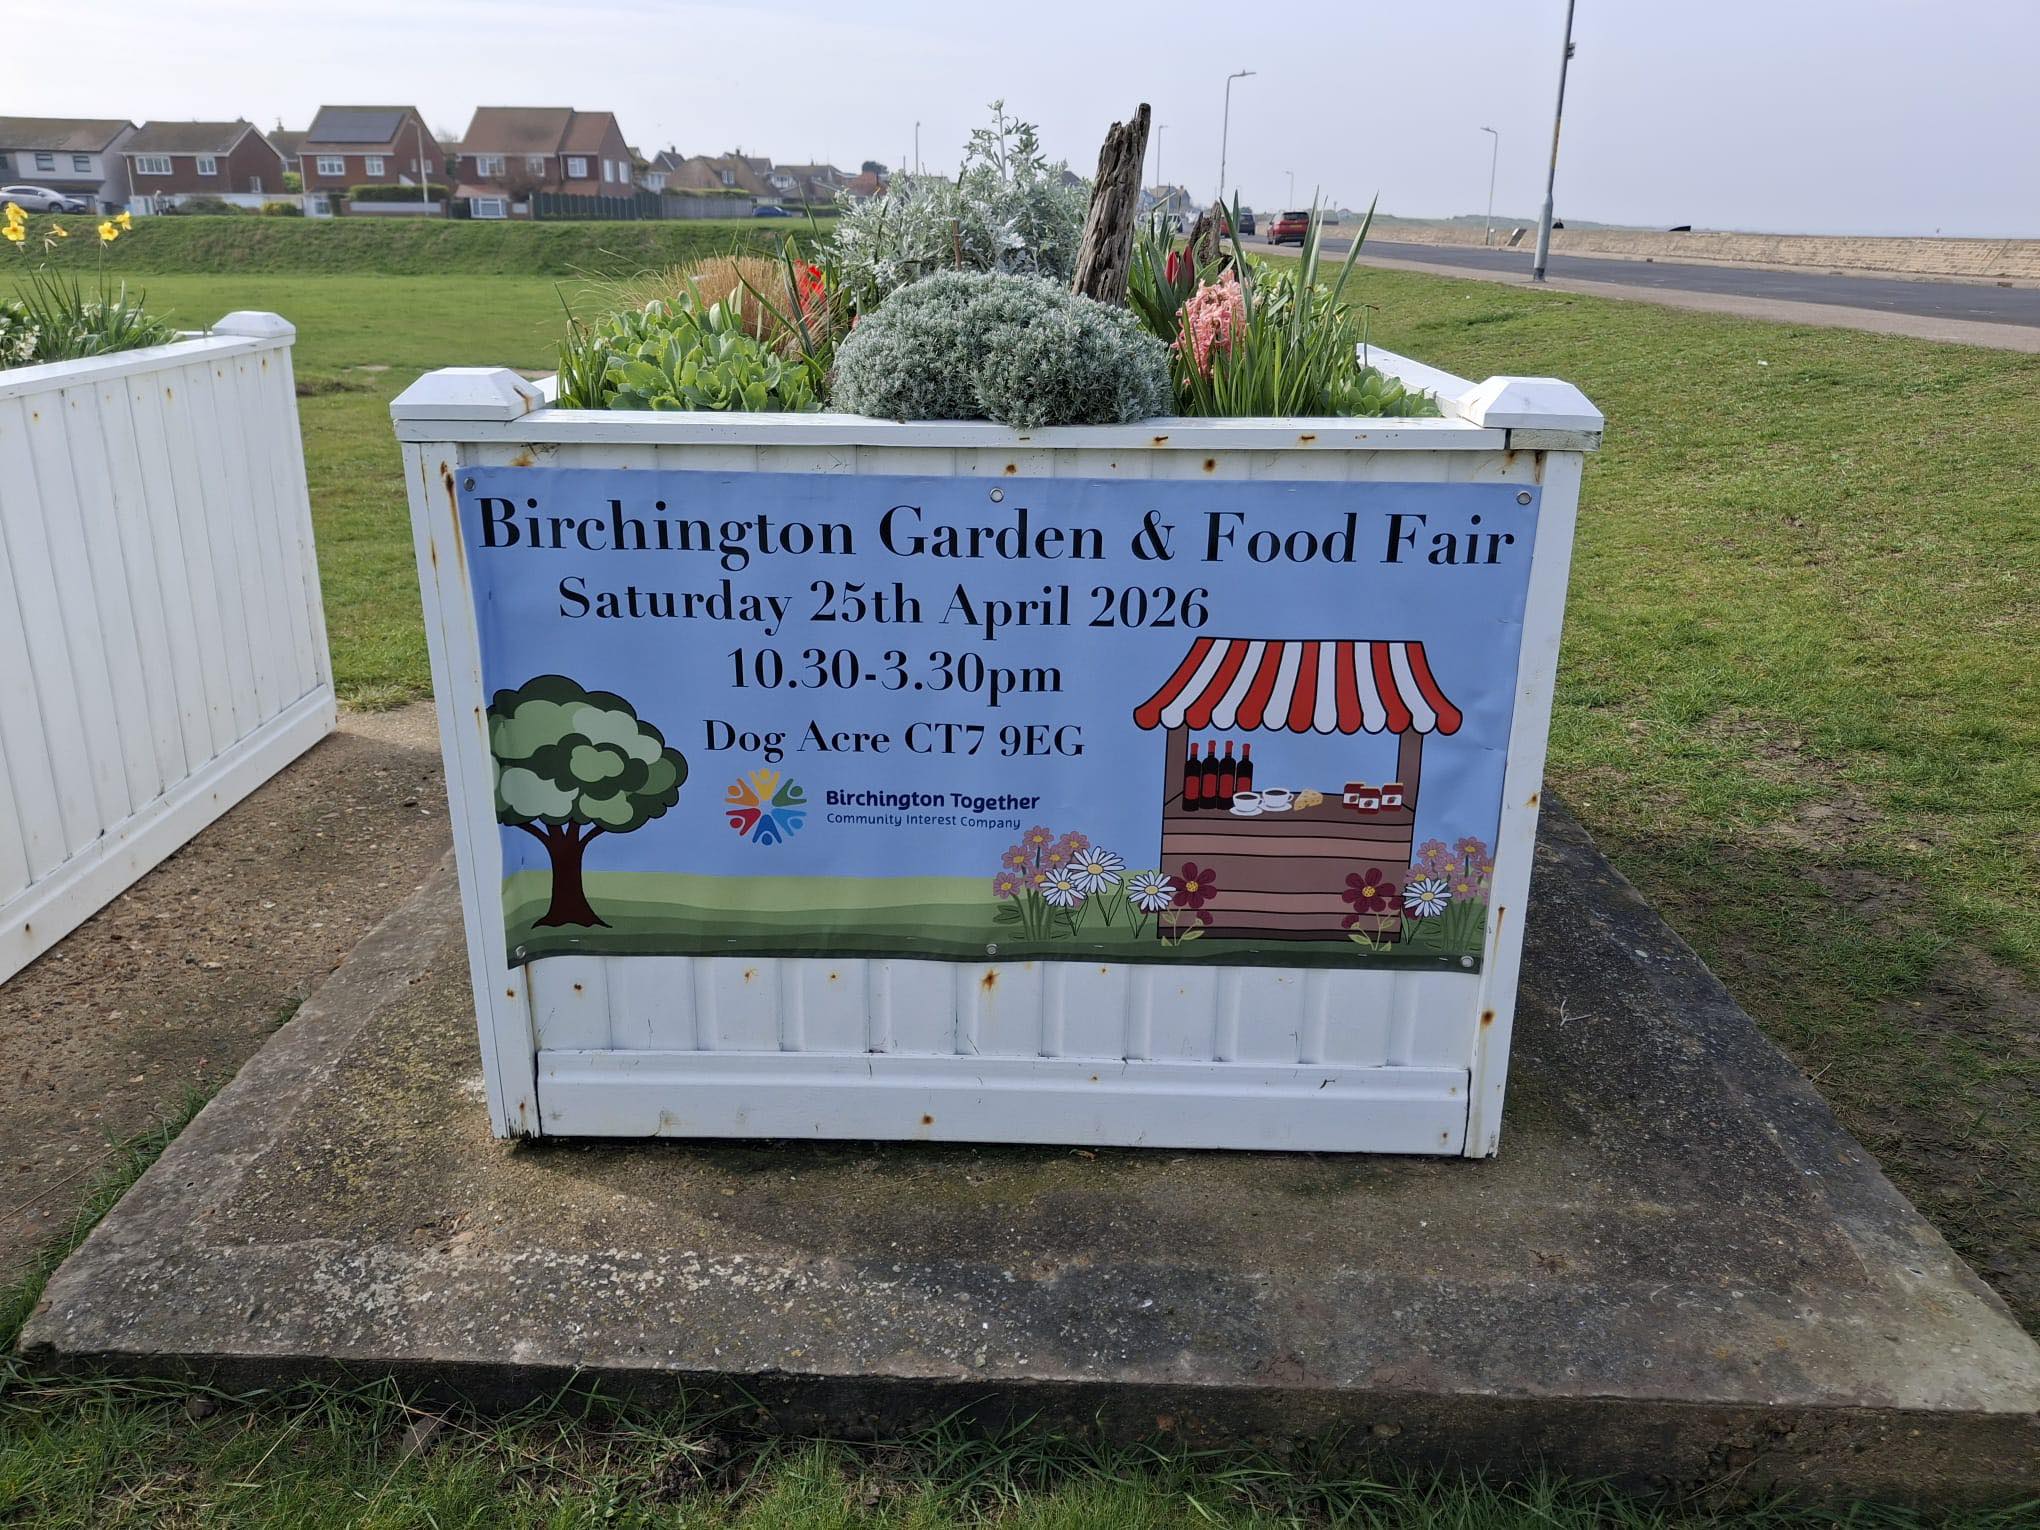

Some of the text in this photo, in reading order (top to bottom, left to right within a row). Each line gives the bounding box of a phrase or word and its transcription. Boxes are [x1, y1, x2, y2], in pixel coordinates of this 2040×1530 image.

[475, 496, 1516, 573] Birchington Garden & Food Fair
[559, 576, 1208, 640] Saturday 25th April 2026
[728, 647, 1063, 708] 10.30-3.30pm
[703, 719, 1084, 764] Dog Acre CT7 9EG
[826, 790, 1041, 813] Birchington Together
[827, 813, 1021, 831] Community Interest Company
